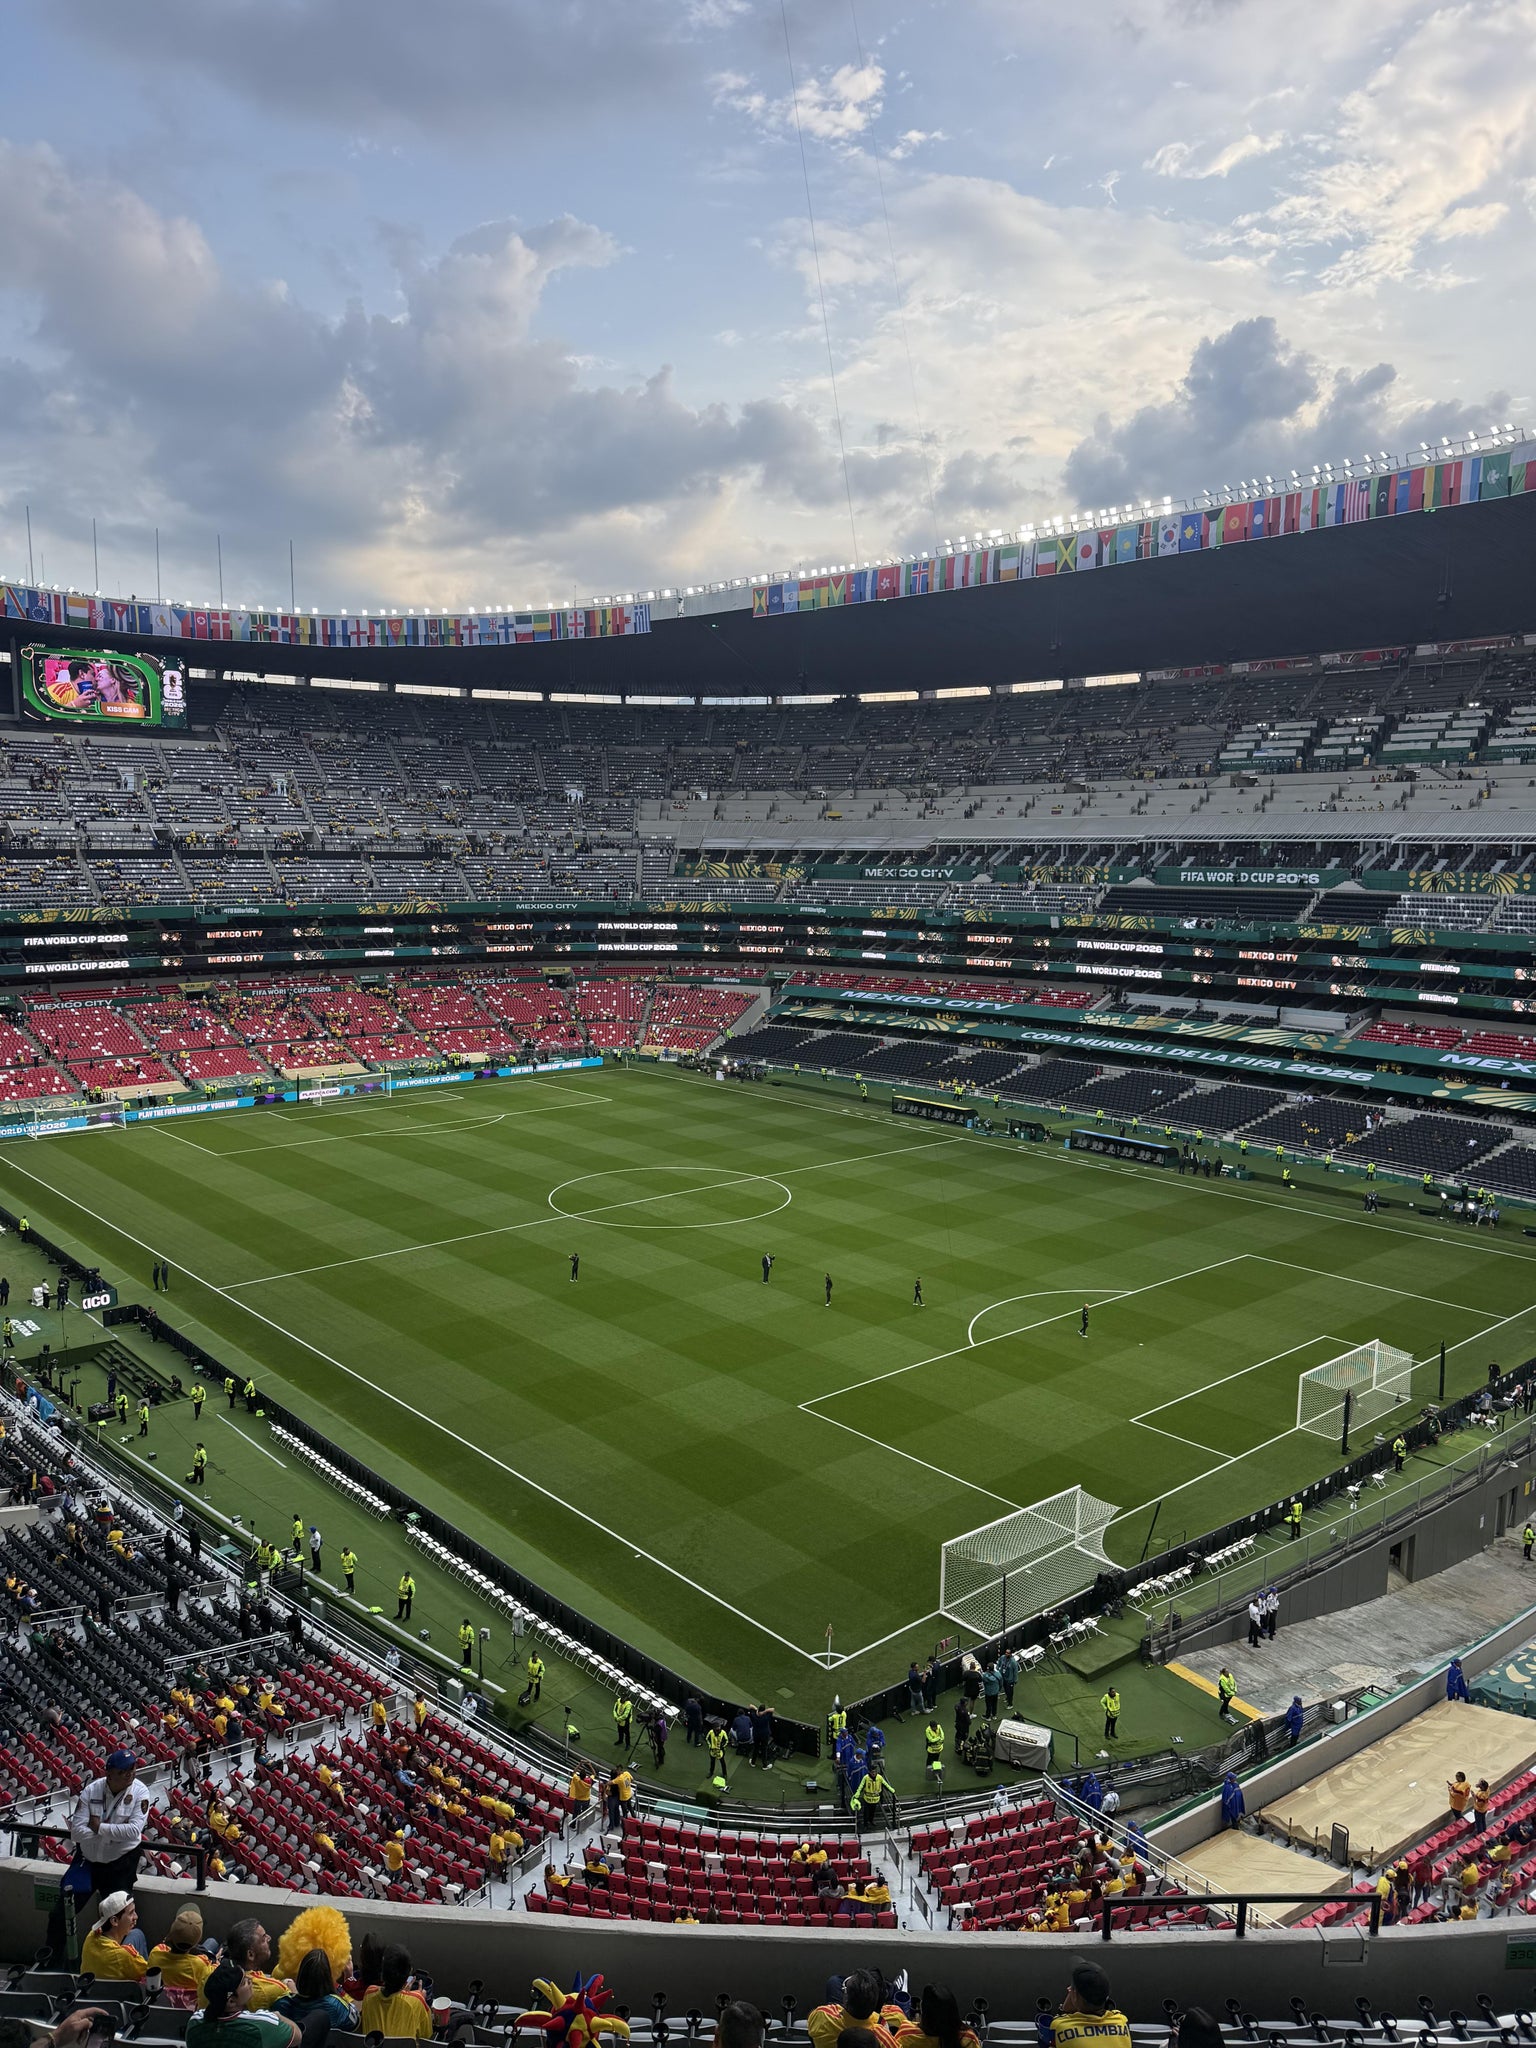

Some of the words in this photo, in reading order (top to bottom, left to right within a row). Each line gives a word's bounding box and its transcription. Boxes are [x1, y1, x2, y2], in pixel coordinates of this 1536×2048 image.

[865, 868, 918, 878] MEXICO
[921, 869, 954, 878] CITY
[1180, 872, 1205, 882] FIFA
[1206, 872, 1249, 882] WORD
[1250, 872, 1275, 883] CUP
[1276, 873, 1320, 884] 2026
[24, 938, 45, 946] FIFA
[45, 936, 77, 945] WORLD
[79, 935, 96, 944] CUP
[97, 934, 129, 943] 2026
[207, 930, 241, 939] MEXICO
[967, 935, 995, 943] MEXICO
[995, 936, 1013, 944] CITY
[1077, 940, 1093, 949] FIFA
[1093, 941, 1120, 951] WORLD
[1120, 943, 1135, 952] CUP
[1135, 944, 1164, 954] 2026
[208, 955, 242, 963] MEXICO
[1239, 951, 1274, 961] MEXICO
[1275, 953, 1298, 962] CITY
[26, 965, 46, 973] FIFA
[46, 963, 78, 972] WORLD
[80, 962, 97, 970] CUP
[98, 961, 129, 969] 2026
[966, 958, 994, 967] MEXICO
[995, 959, 1012, 968] CITY
[1076, 965, 1091, 974] FIFA
[1092, 966, 1118, 976] WORLD
[1119, 968, 1134, 977] CUP
[1134, 970, 1162, 979] 2026
[1237, 977, 1273, 988] MEXICO
[1274, 980, 1297, 989] CITY
[34, 1001, 83, 1011] MEXICO
[84, 999, 113, 1008] CITY
[839, 991, 942, 1005] MEXICO
[944, 1000, 1014, 1011] CITY
[1020, 1031, 1072, 1044] COPA
[1073, 1037, 1163, 1054] MUNDIAL
[1166, 1048, 1196, 1059] DE
[1198, 1051, 1228, 1063] LA
[1229, 1056, 1282, 1069] FIFA
[1284, 1063, 1375, 1082] 2026
[1438, 1054, 1536, 1074] MEX
[0, 1127, 21, 1136] ORLD
[24, 1125, 40, 1133] CUP
[40, 1122, 68, 1130] 2026
[1057, 2025, 1129, 2043] COLOMBIA
